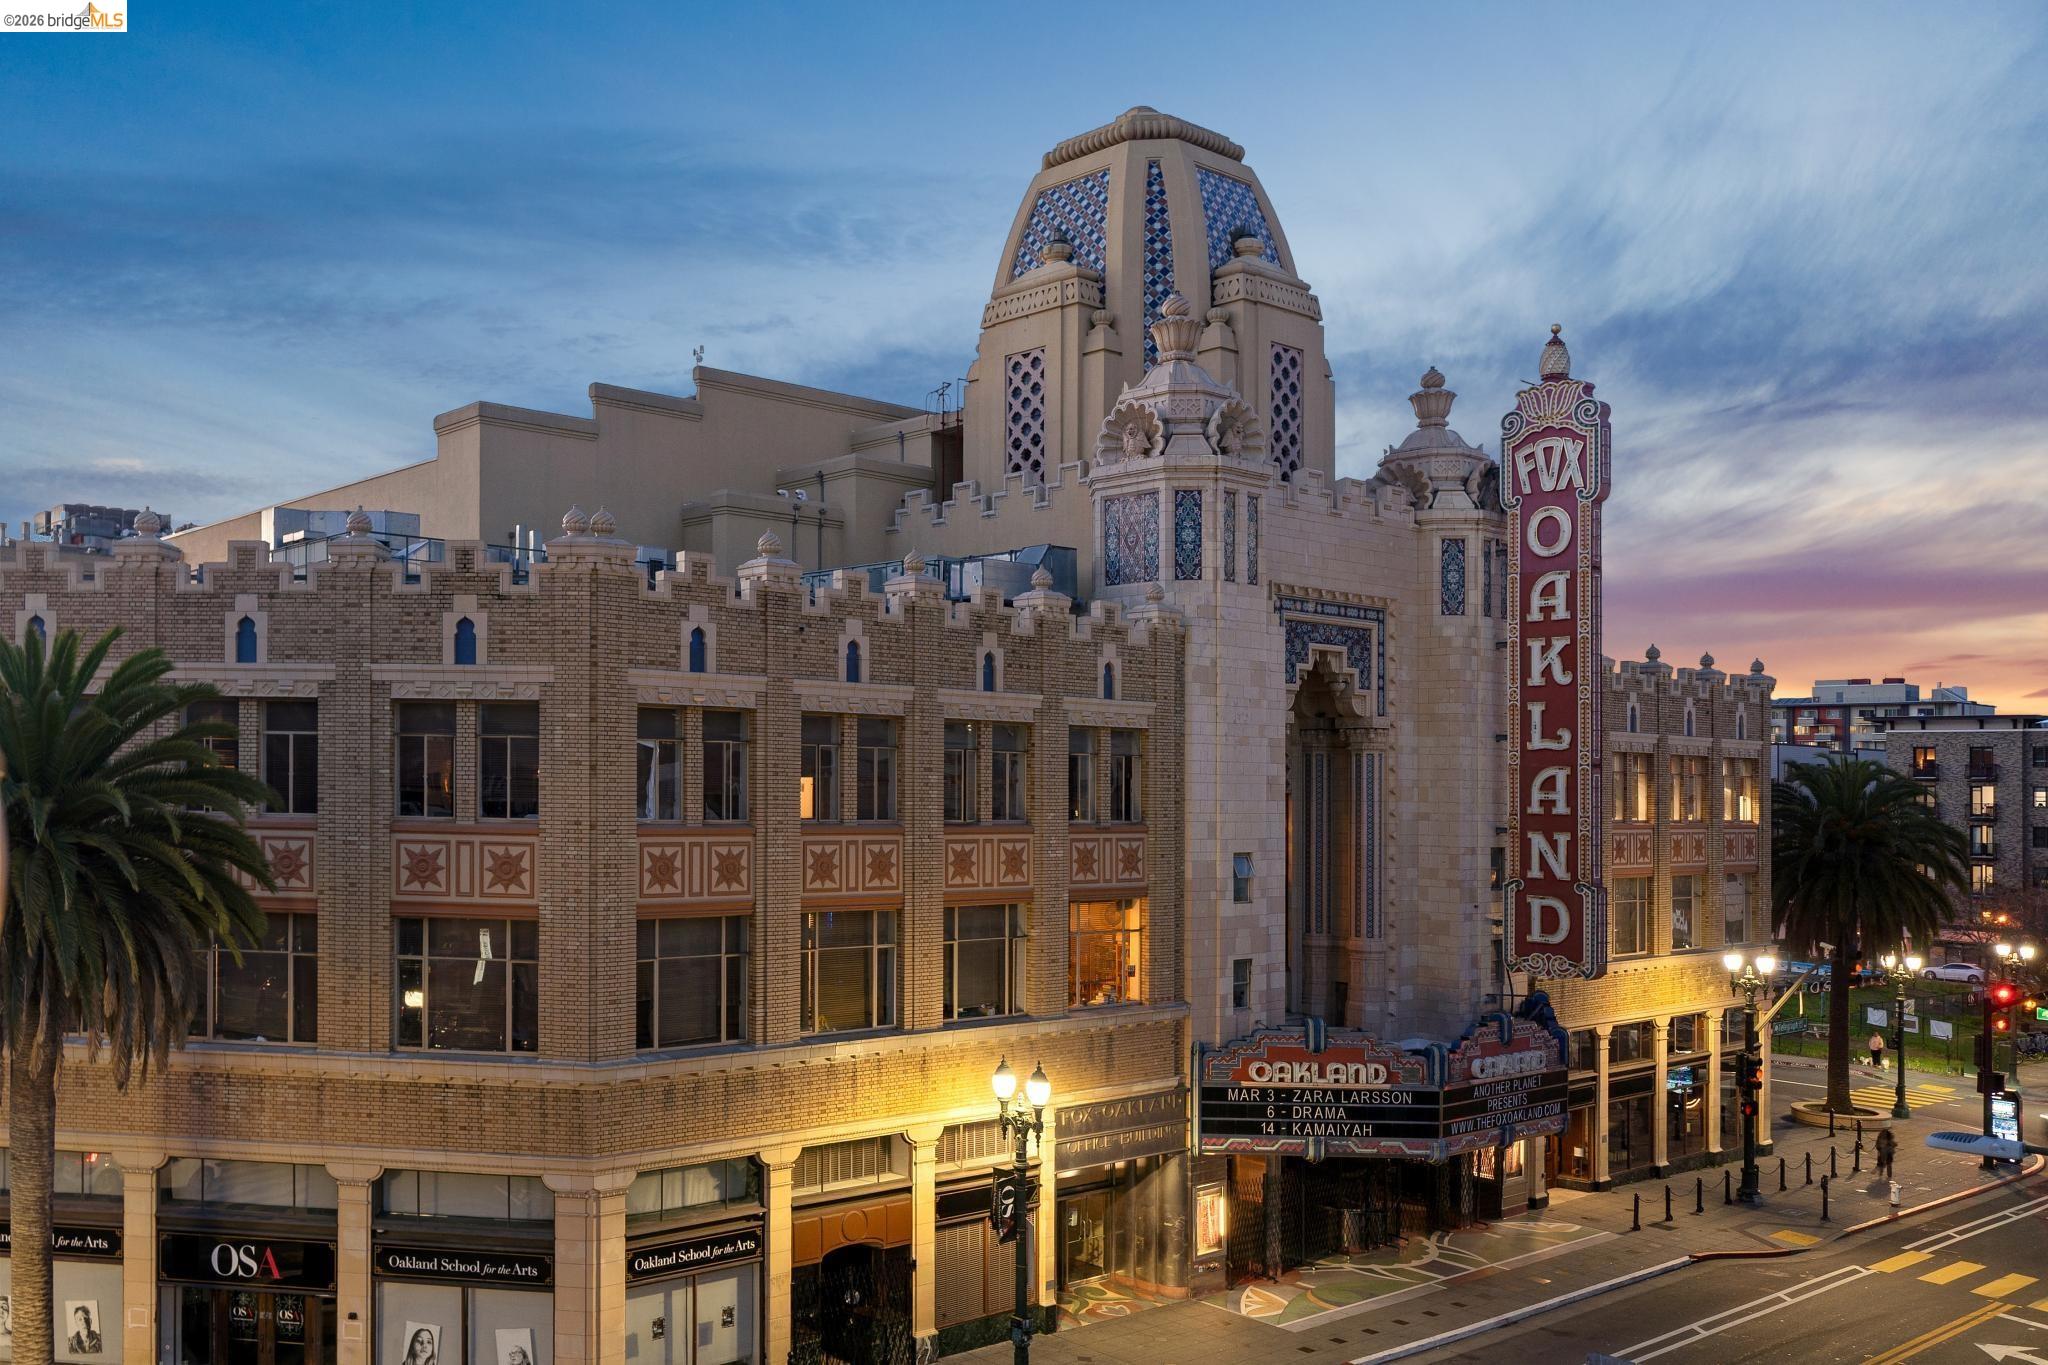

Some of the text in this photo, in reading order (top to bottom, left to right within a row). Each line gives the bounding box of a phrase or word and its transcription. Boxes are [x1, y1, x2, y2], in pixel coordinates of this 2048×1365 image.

[1515, 436, 1584, 494] FOX
[1526, 505, 1573, 944] OAKLAND
[1248, 1061, 1387, 1084] OAKLAND
[1227, 1089, 1260, 1102] MAR
[1267, 1089, 1275, 1102] 3
[1292, 1089, 1334, 1102] ZARA
[1341, 1091, 1412, 1104] LARSSON
[1473, 1075, 1541, 1098] ANOTHER PLANET
[1267, 1105, 1275, 1119] 6
[1292, 1106, 1347, 1120] DRAMA
[1487, 1093, 1528, 1112] PRESENTS
[1260, 1122, 1275, 1135] 14
[1292, 1123, 1373, 1137] KAMAIYAH
[1450, 1103, 1561, 1135] WWW.THEFOXOAKLAND.COM
[55, 1236, 71, 1248] for
[71, 1236, 83, 1247] the
[84, 1235, 108, 1249] Arts
[211, 1243, 283, 1279] OSA
[389, 1255, 538, 1277] Oakland School for the Arts
[635, 1239, 756, 1271] Oakland School for the Arts
